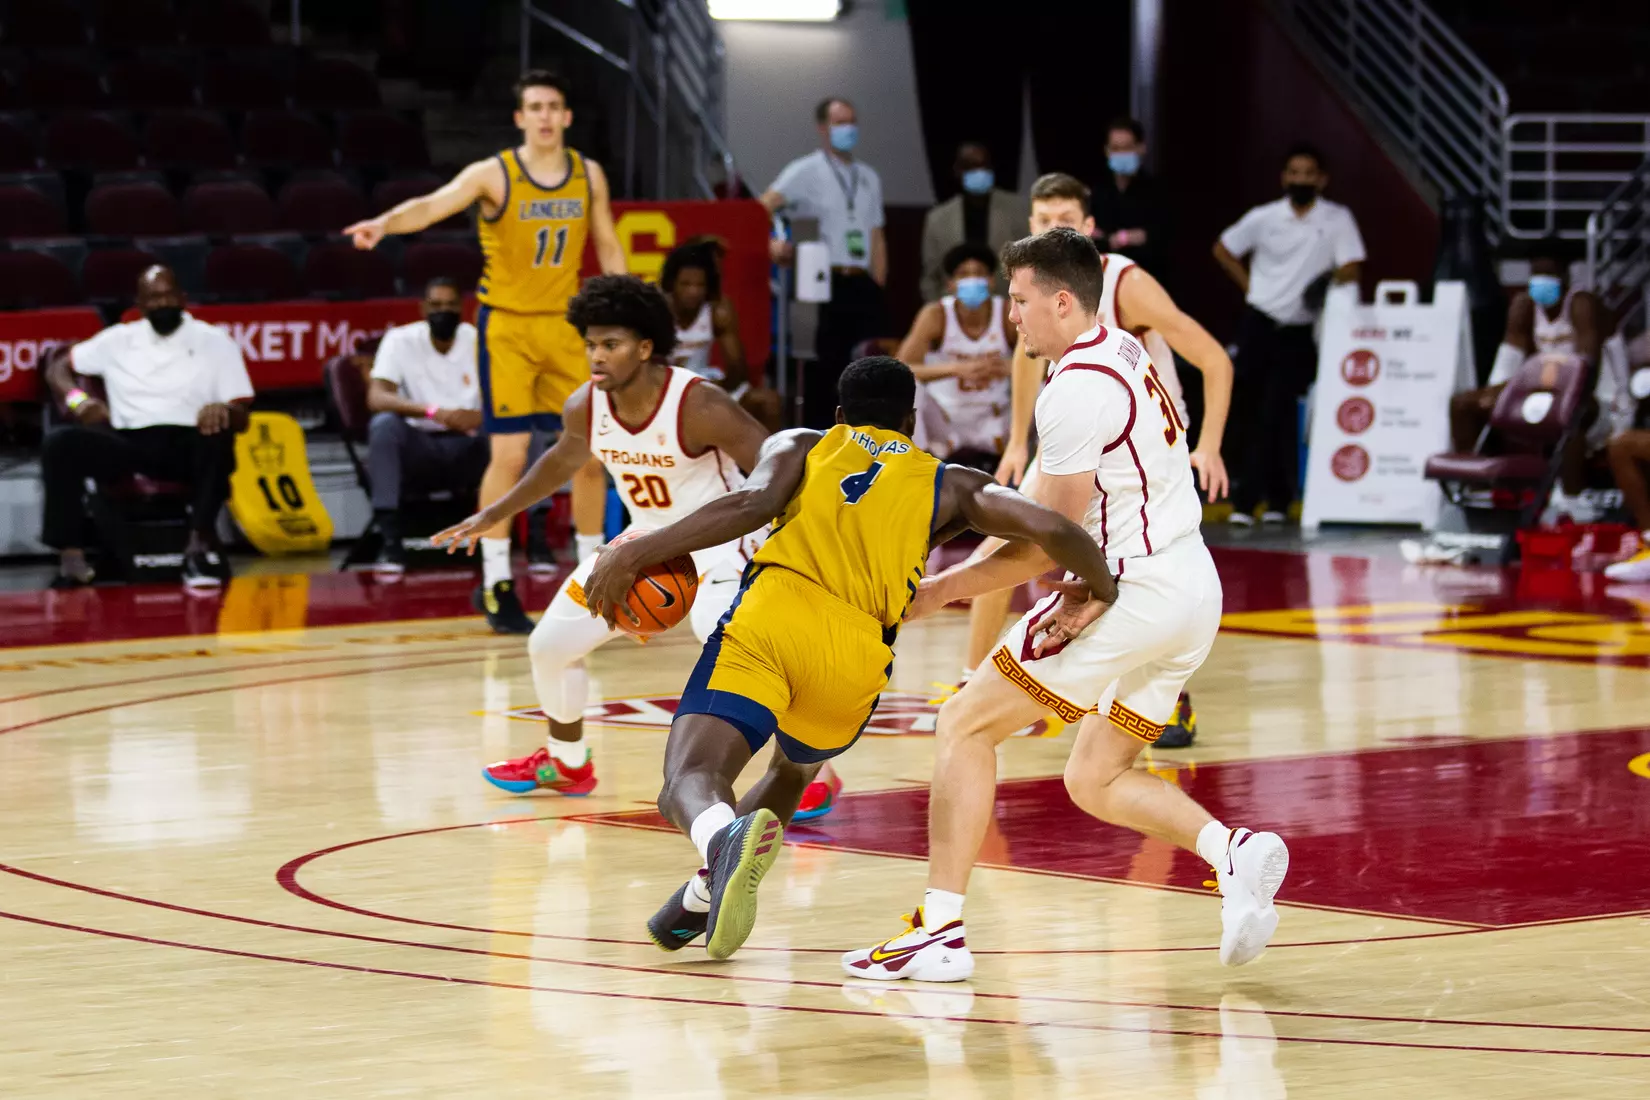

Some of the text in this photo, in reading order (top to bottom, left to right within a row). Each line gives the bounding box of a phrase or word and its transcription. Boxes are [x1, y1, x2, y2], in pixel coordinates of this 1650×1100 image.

[518, 198, 584, 221] LANCERS
[532, 224, 570, 268] 11
[217, 320, 312, 361] KET
[600, 449, 675, 468] TROJANS
[257, 474, 304, 511] 10
[622, 473, 672, 508] 20
[840, 460, 885, 505] 4
